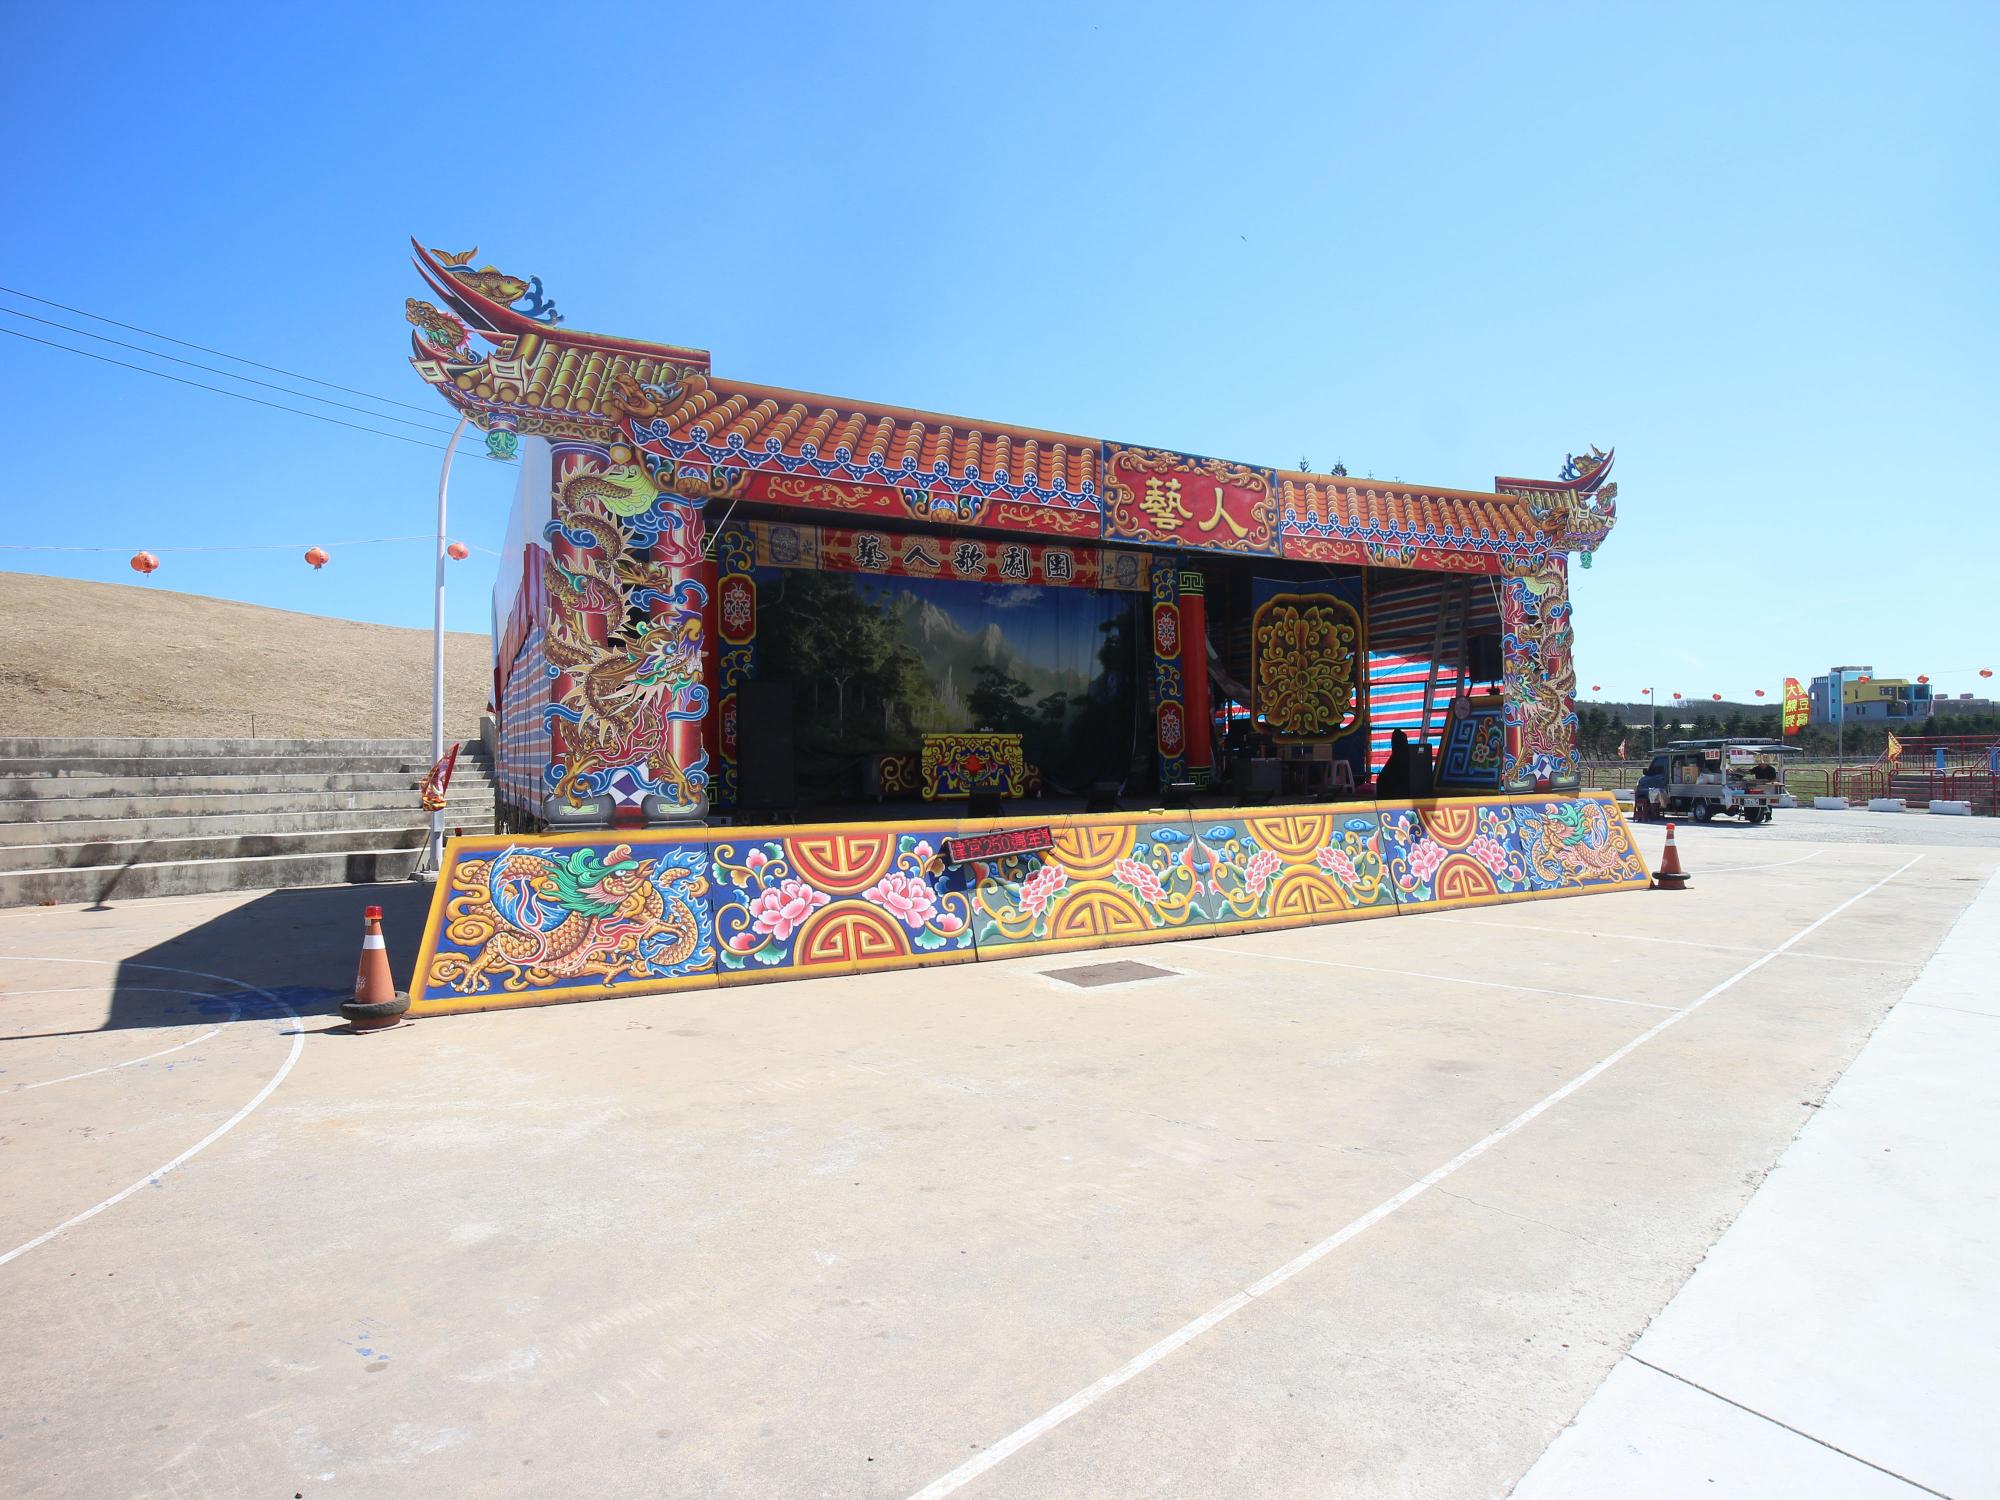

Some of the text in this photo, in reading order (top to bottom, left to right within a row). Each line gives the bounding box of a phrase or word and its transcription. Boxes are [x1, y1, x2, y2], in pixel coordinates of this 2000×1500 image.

[1140, 476, 1249, 539] 藝人
[855, 535, 1073, 580] 藝人歌劇團
